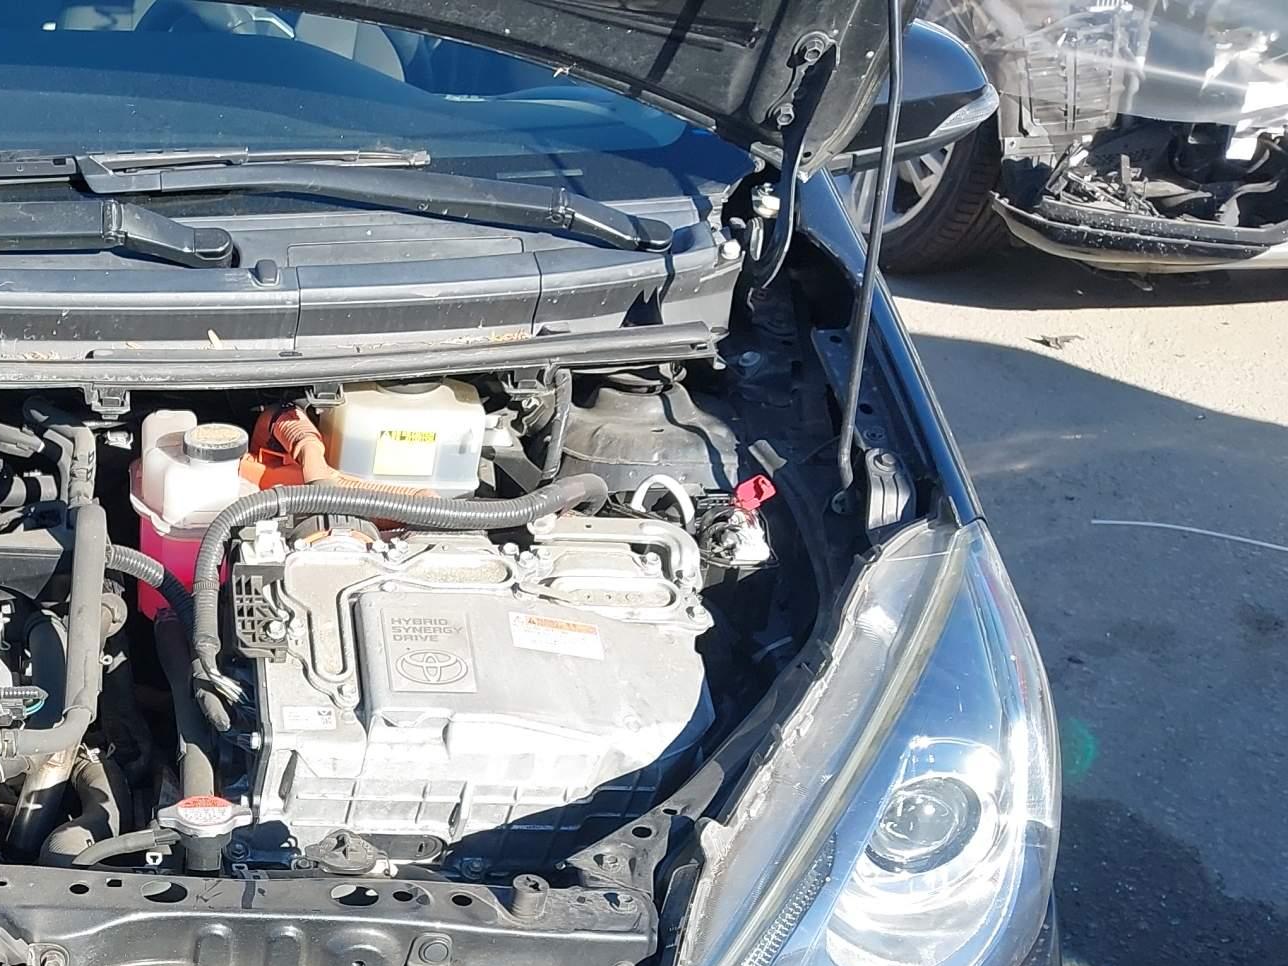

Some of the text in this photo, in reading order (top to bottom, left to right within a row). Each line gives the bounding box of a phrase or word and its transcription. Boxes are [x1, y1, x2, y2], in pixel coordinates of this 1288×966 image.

[390, 617, 449, 626] HYBRID
[391, 625, 463, 634] SYNERGY
[392, 634, 439, 642] DRIVE
